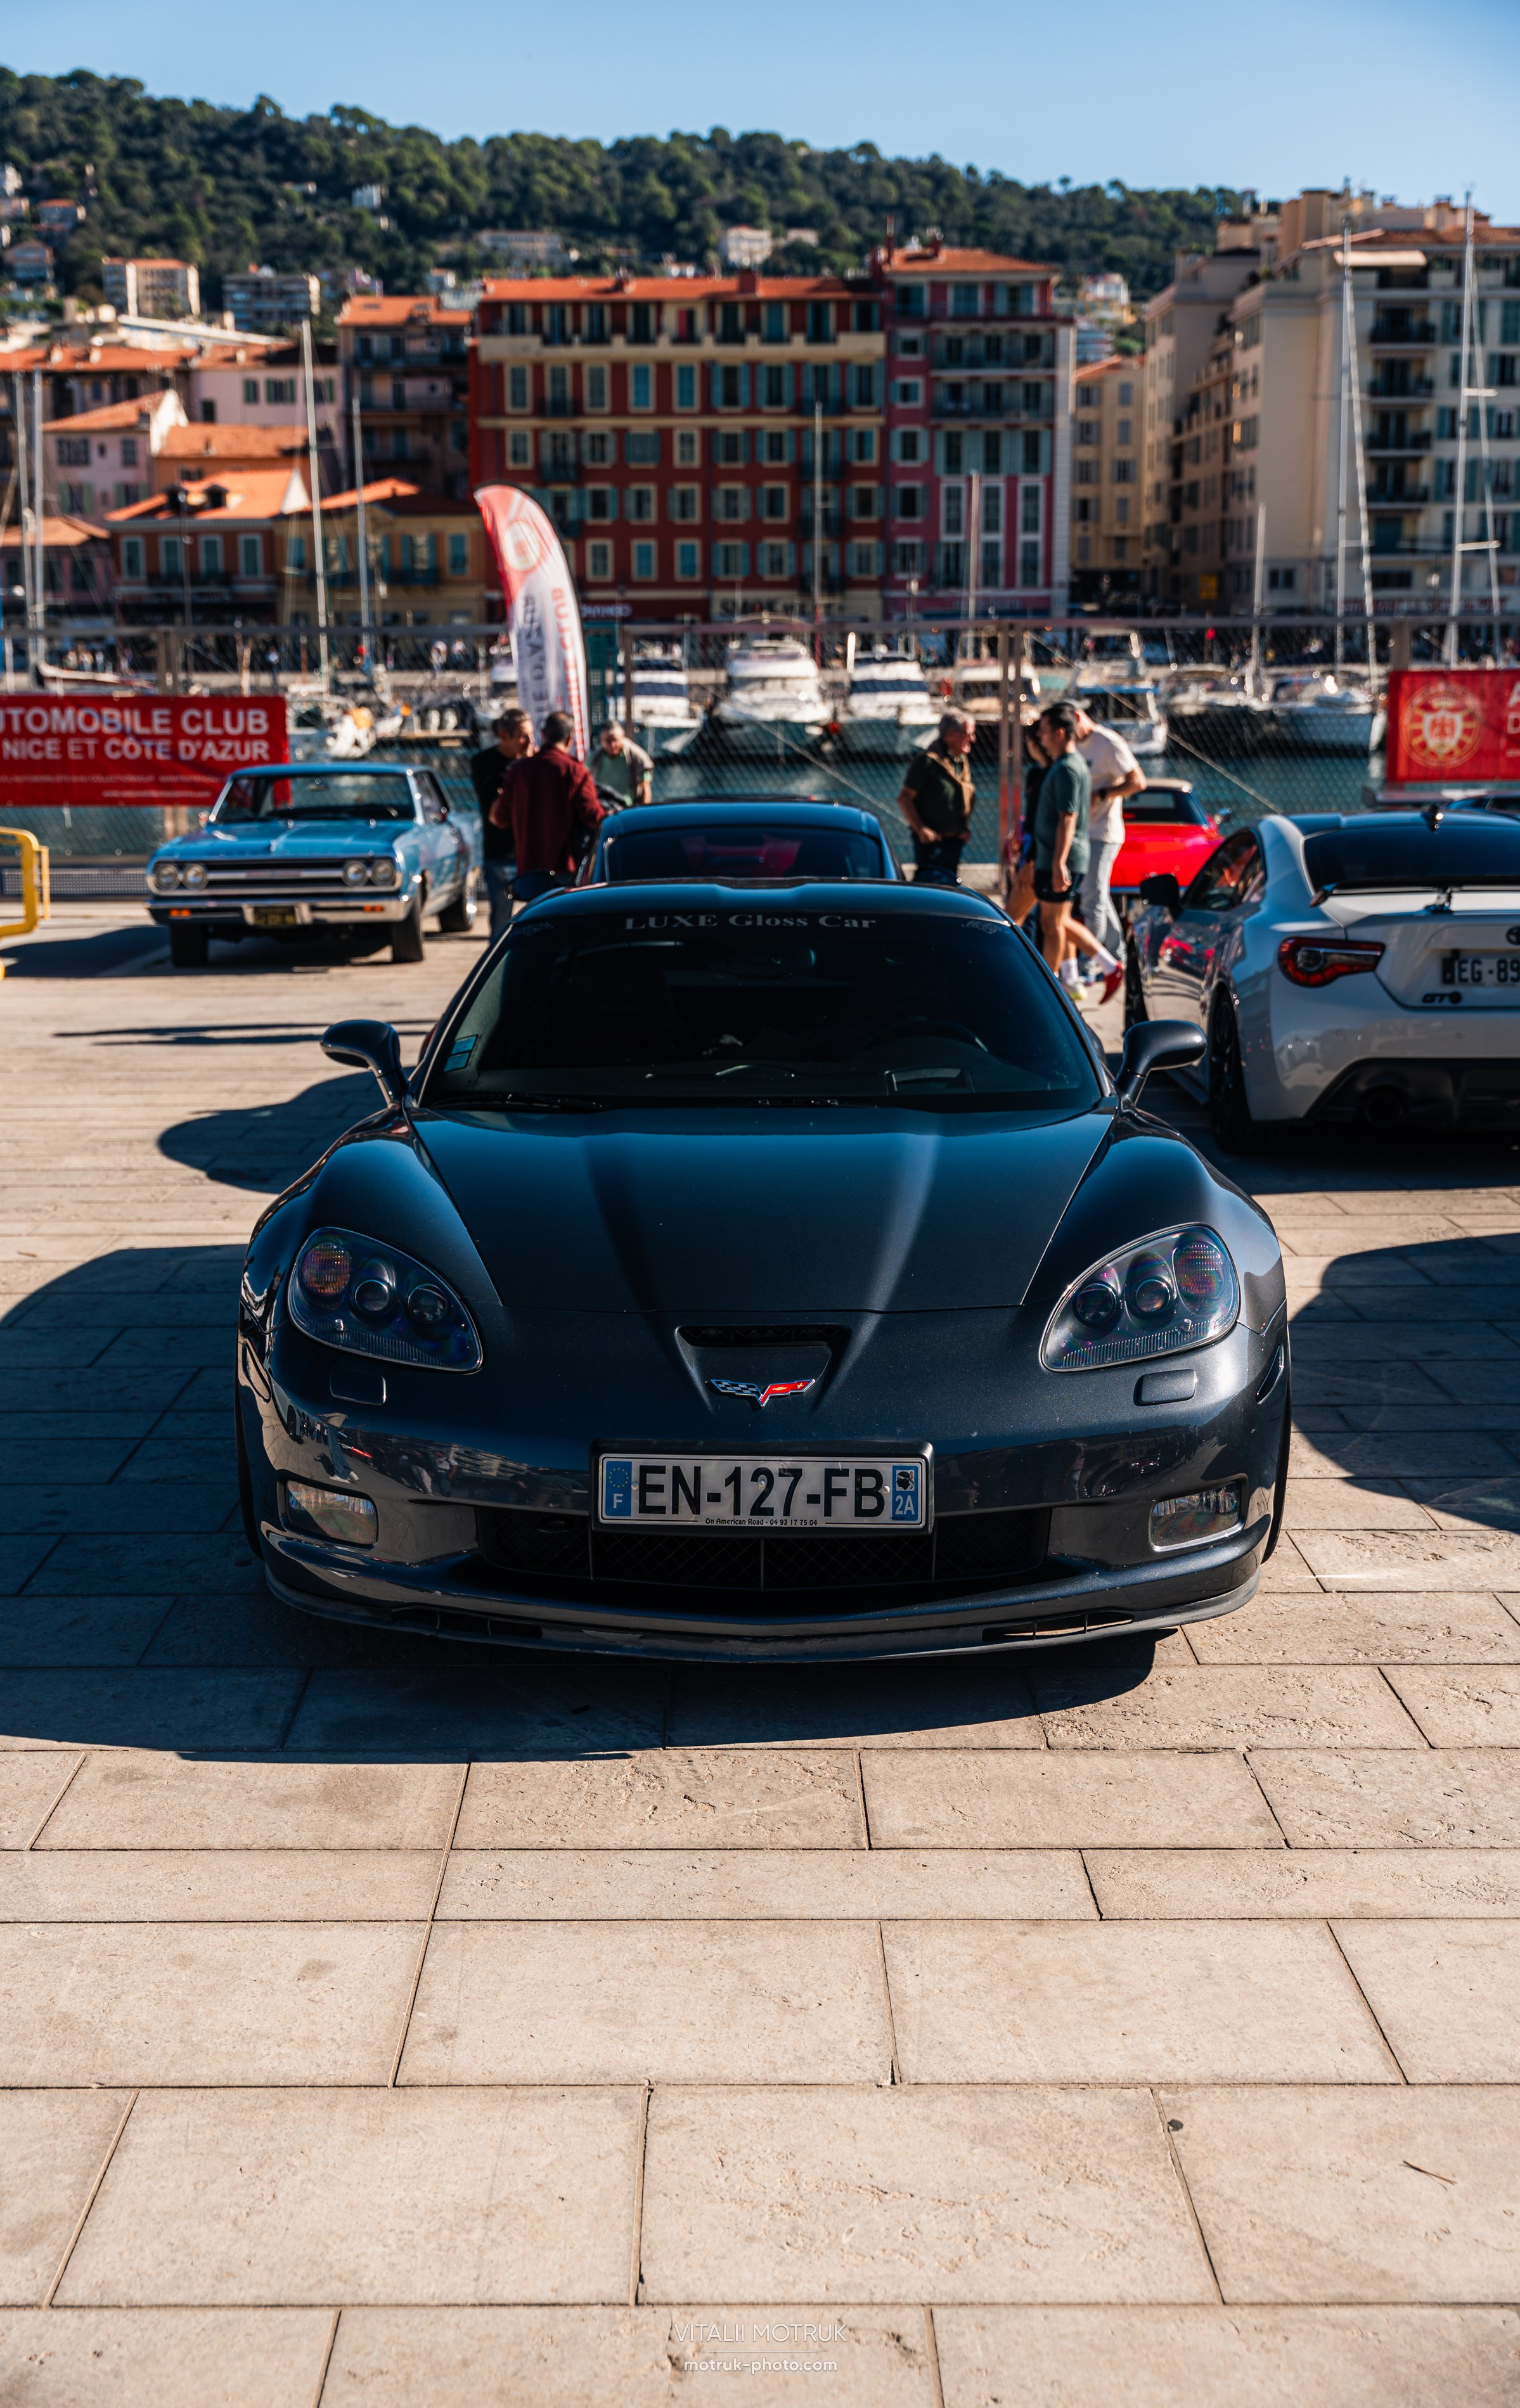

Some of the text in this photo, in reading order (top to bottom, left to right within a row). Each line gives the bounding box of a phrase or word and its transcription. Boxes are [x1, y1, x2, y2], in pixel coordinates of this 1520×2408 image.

[180, 708, 270, 735] CLUB
[2, 738, 61, 760] NICE
[67, 739, 98, 760] ET
[178, 739, 270, 761] D'AZUR
[623, 914, 876, 930] LUXE Gloss Car
[612, 1494, 624, 1509] F
[638, 1465, 886, 1518] EN-127-FB
[895, 1495, 915, 1515] 2A
